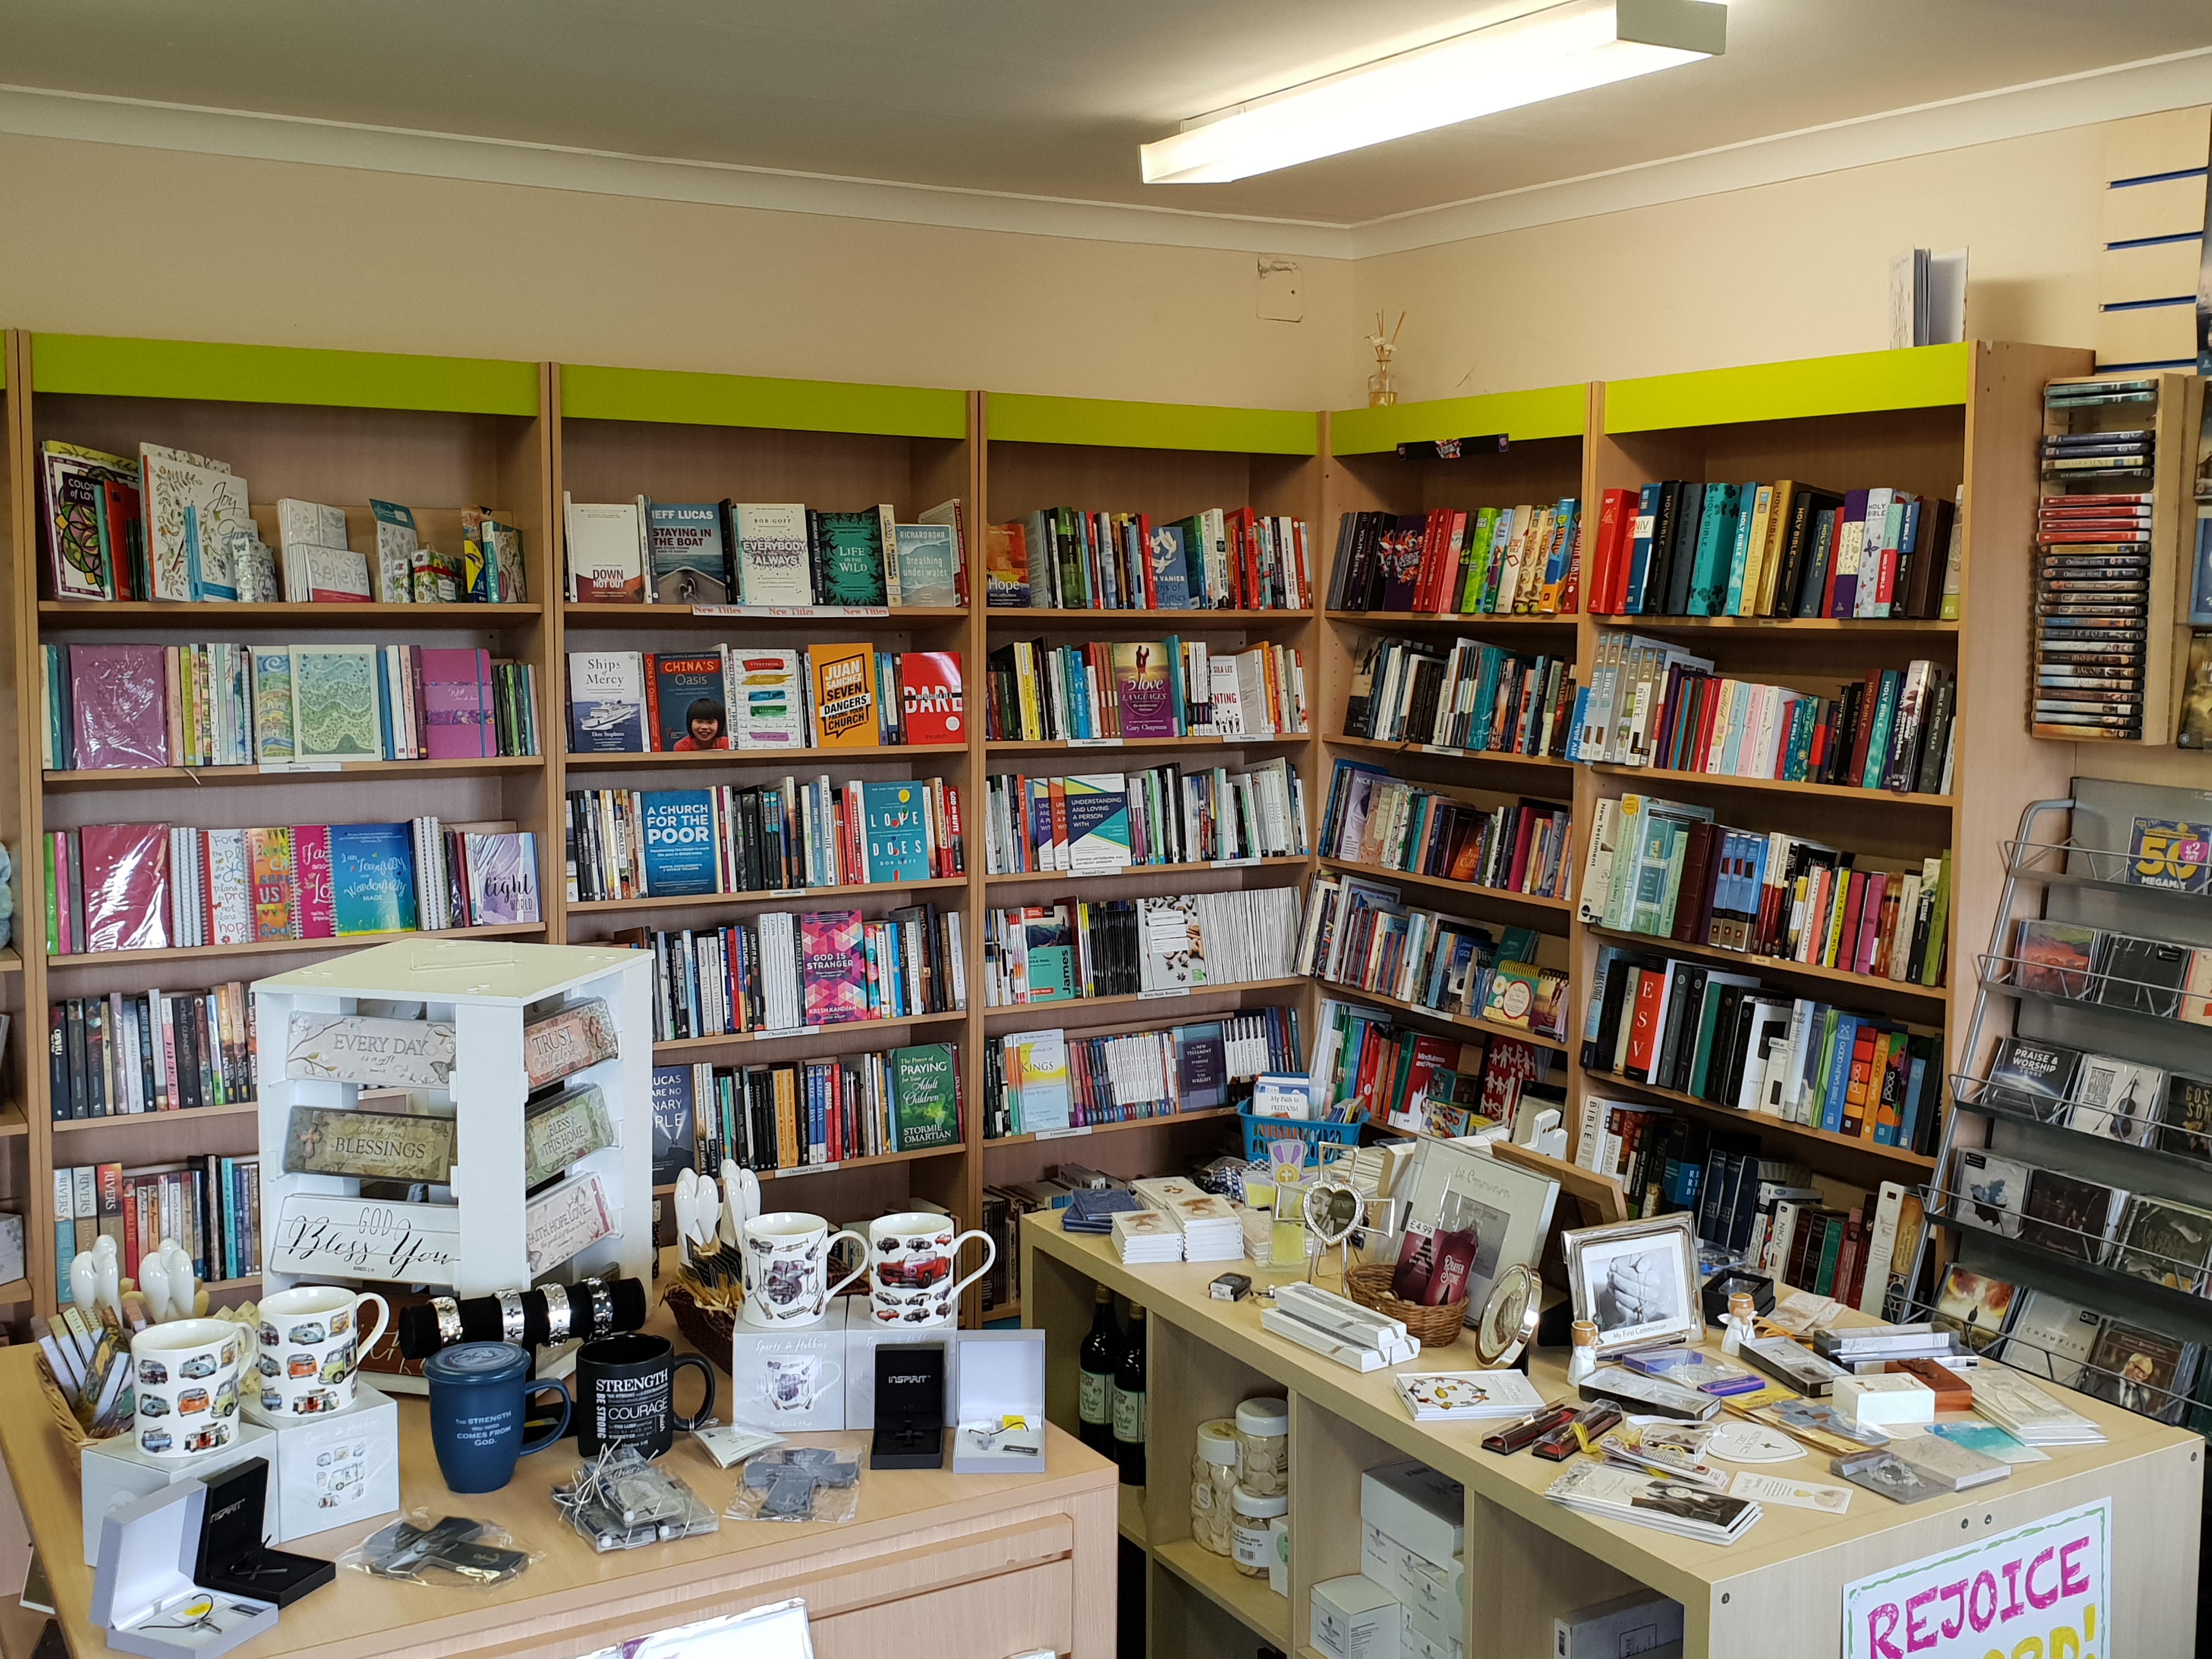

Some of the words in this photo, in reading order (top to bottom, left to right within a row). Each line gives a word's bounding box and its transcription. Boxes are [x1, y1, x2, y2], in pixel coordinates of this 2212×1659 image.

[204, 482, 245, 515] Joy
[1663, 495, 1672, 518] HOLY
[1770, 492, 1782, 516] HOLY
[678, 510, 714, 520] LUCAS
[1738, 511, 1748, 533] HOLY
[1794, 507, 1805, 529] HOLY
[653, 528, 697, 537] STAYING
[700, 529, 712, 537] IN
[900, 531, 928, 539] RICHARD
[928, 531, 946, 539] ROHR
[1658, 520, 1668, 546] BIBLE
[1701, 521, 1711, 548] BIBLE
[1767, 517, 1778, 546] BIBLE
[1819, 523, 1829, 545] HOLY
[654, 538, 675, 546] THE
[677, 538, 704, 546] BOAT
[742, 541, 806, 551] EVERYBODY
[1735, 533, 1745, 557] BIBLE
[1790, 531, 1801, 555] BIBLE
[839, 546, 865, 556] LIFE
[1815, 545, 1825, 567] BIBLE
[755, 555, 799, 566] ALWAYS
[839, 562, 868, 572] WILD
[906, 555, 943, 567] breathing
[592, 569, 624, 580] DOWN
[902, 567, 925, 577] under
[926, 568, 947, 577] water
[592, 580, 607, 589] NOT
[608, 580, 625, 589] OUT
[988, 577, 1020, 593] Hope
[694, 606, 713, 614] New
[717, 606, 742, 614] Titles
[769, 607, 788, 616] New
[791, 607, 814, 616] Titles
[843, 607, 863, 616] New
[865, 607, 888, 616] Titles
[587, 658, 622, 672] Ships
[664, 661, 715, 673] CHINA'S
[825, 659, 861, 681] JUAN
[1213, 665, 1224, 674] SILA
[1224, 665, 1233, 673] LEE
[586, 674, 624, 686] Mercy
[675, 674, 708, 686] Oasis
[825, 674, 863, 690] SANCHEZ
[1127, 675, 1137, 691] 5
[1137, 675, 1164, 691] love
[826, 683, 862, 702] SEVEN
[904, 685, 963, 714] DARE
[1122, 692, 1167, 701] LANGUAGES
[1882, 680, 1892, 703] HOLY
[824, 695, 867, 715] DANGERS
[1633, 687, 1645, 718] BIBLE
[828, 714, 865, 731] CHURCH
[1876, 703, 1887, 729] BIBLE
[647, 806, 657, 816] A
[659, 804, 709, 815] CHURCH
[1071, 797, 1123, 806] UNDERSTANDING
[647, 816, 679, 828] FOR
[681, 815, 709, 826] THE
[870, 811, 919, 828] LOVE
[617, 821, 625, 855] BOUNDLESS
[647, 826, 710, 845] POOR
[872, 839, 922, 857] DOES
[1590, 821, 1603, 868] Testament
[2136, 838, 2198, 878] 50
[259, 887, 281, 904] US
[510, 898, 533, 911] WORLD
[806, 960, 854, 970] STRANGER
[812, 953, 833, 962] GOD
[1061, 949, 1071, 994] James
[333, 1032, 390, 1053] EVERY
[392, 1037, 429, 1057] DAY
[532, 1025, 573, 1056] TRUST
[1837, 1041, 1846, 1064] GOOD
[2014, 1048, 2050, 1063] PRAISE
[900, 1061, 948, 1076] PRAYING
[1020, 1061, 1054, 1073] KINGS
[2012, 1057, 2057, 1073] WORSHIP
[2019, 1068, 2043, 1077] SONGS
[1833, 1064, 1843, 1085] NEWS
[1851, 1064, 1862, 1094] good
[669, 1087, 682, 1096] NO
[911, 1075, 940, 1092] Adult
[1884, 1071, 1895, 1102] good
[902, 1089, 940, 1106] Children
[548, 1115, 571, 1138] BLESS
[1583, 1101, 1598, 1141] BIBLE
[356, 1124, 385, 1137] Count
[903, 1124, 943, 1136] STORMIE
[904, 1130, 952, 1143] OMARTIAN
[334, 1137, 426, 1159] BLESSINGS
[541, 1133, 562, 1156] THIS
[562, 1124, 586, 1147] HOME
[58, 1177, 69, 1214] RIVERS
[78, 1173, 90, 1213] RIVERS
[104, 1171, 116, 1210] RIVERS
[358, 1206, 394, 1237] GOD
[1409, 1218, 1433, 1235] £4.99
[526, 1222, 549, 1247] FAITH
[1776, 1221, 1786, 1249] NKJV
[288, 1214, 381, 1263] Bless
[390, 1217, 461, 1278] You
[1443, 1254, 1464, 1275] PRAYER
[1612, 1331, 1623, 1340] My
[1635, 1322, 1667, 1336] Communion
[755, 1340, 782, 1352] Sports
[795, 1340, 828, 1353] Hobbies
[2025, 1327, 2086, 1353] CHAMPION
[595, 1368, 669, 1392] STRENGTH
[888, 1375, 927, 1384] INSPIRIT
[596, 1393, 603, 1405] BE
[608, 1397, 668, 1420] COURAGE
[467, 1411, 512, 1425] STRENGTH
[596, 1406, 607, 1439] STRONG
[456, 1432, 487, 1440] COMES
[489, 1426, 512, 1438] FROM
[474, 1437, 498, 1446] GOD.
[1867, 1536, 2091, 1659] REJOICE
